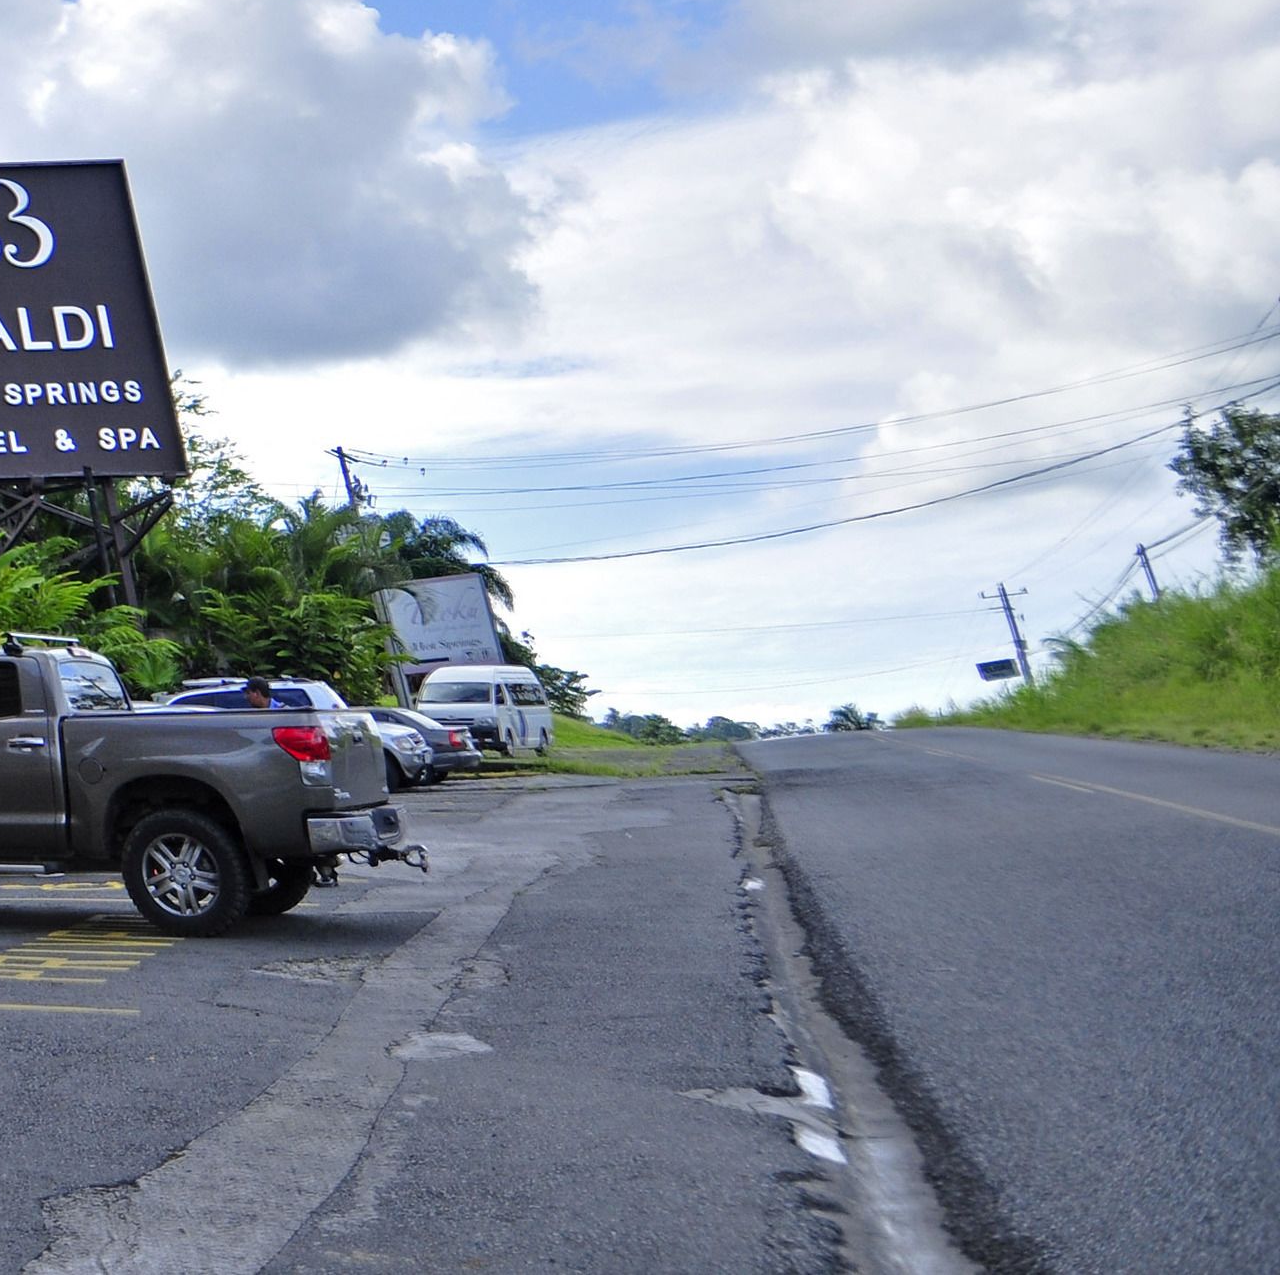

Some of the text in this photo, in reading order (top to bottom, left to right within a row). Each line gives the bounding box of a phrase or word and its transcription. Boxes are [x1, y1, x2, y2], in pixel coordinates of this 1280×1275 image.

[3, 380, 143, 406] SPRINGS
[54, 428, 77, 453] &
[98, 427, 161, 452] SPA
